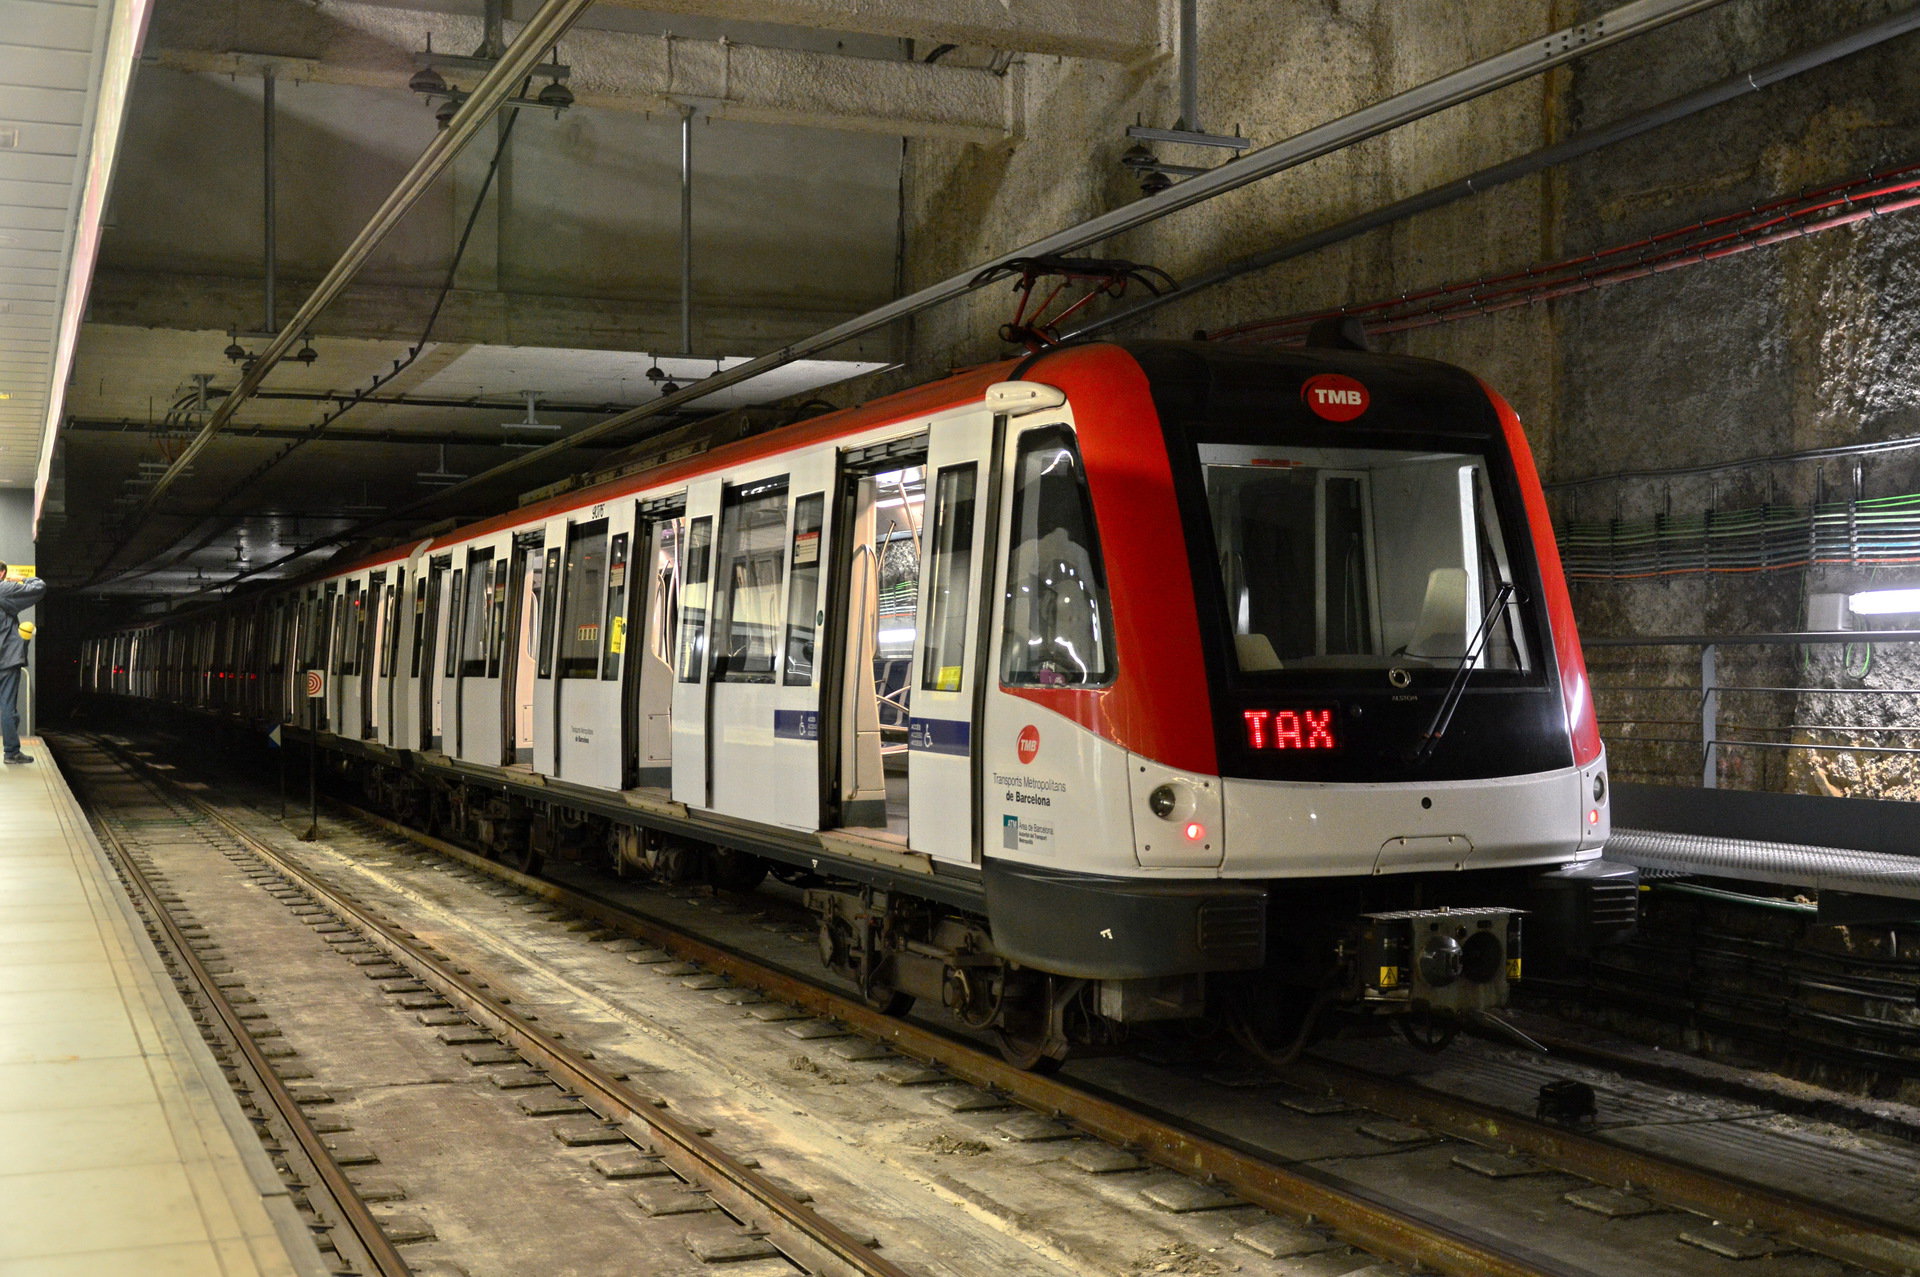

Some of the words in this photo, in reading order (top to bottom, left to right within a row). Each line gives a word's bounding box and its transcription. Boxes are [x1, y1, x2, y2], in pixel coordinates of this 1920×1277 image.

[1315, 388, 1362, 406] TMB
[1244, 711, 1333, 749] TAX
[1020, 739, 1037, 752] TMB
[993, 772, 1023, 788] Transports
[1023, 776, 1067, 793] Metropolitans
[1005, 790, 1014, 802] de
[1015, 791, 1051, 806] Barcelona
